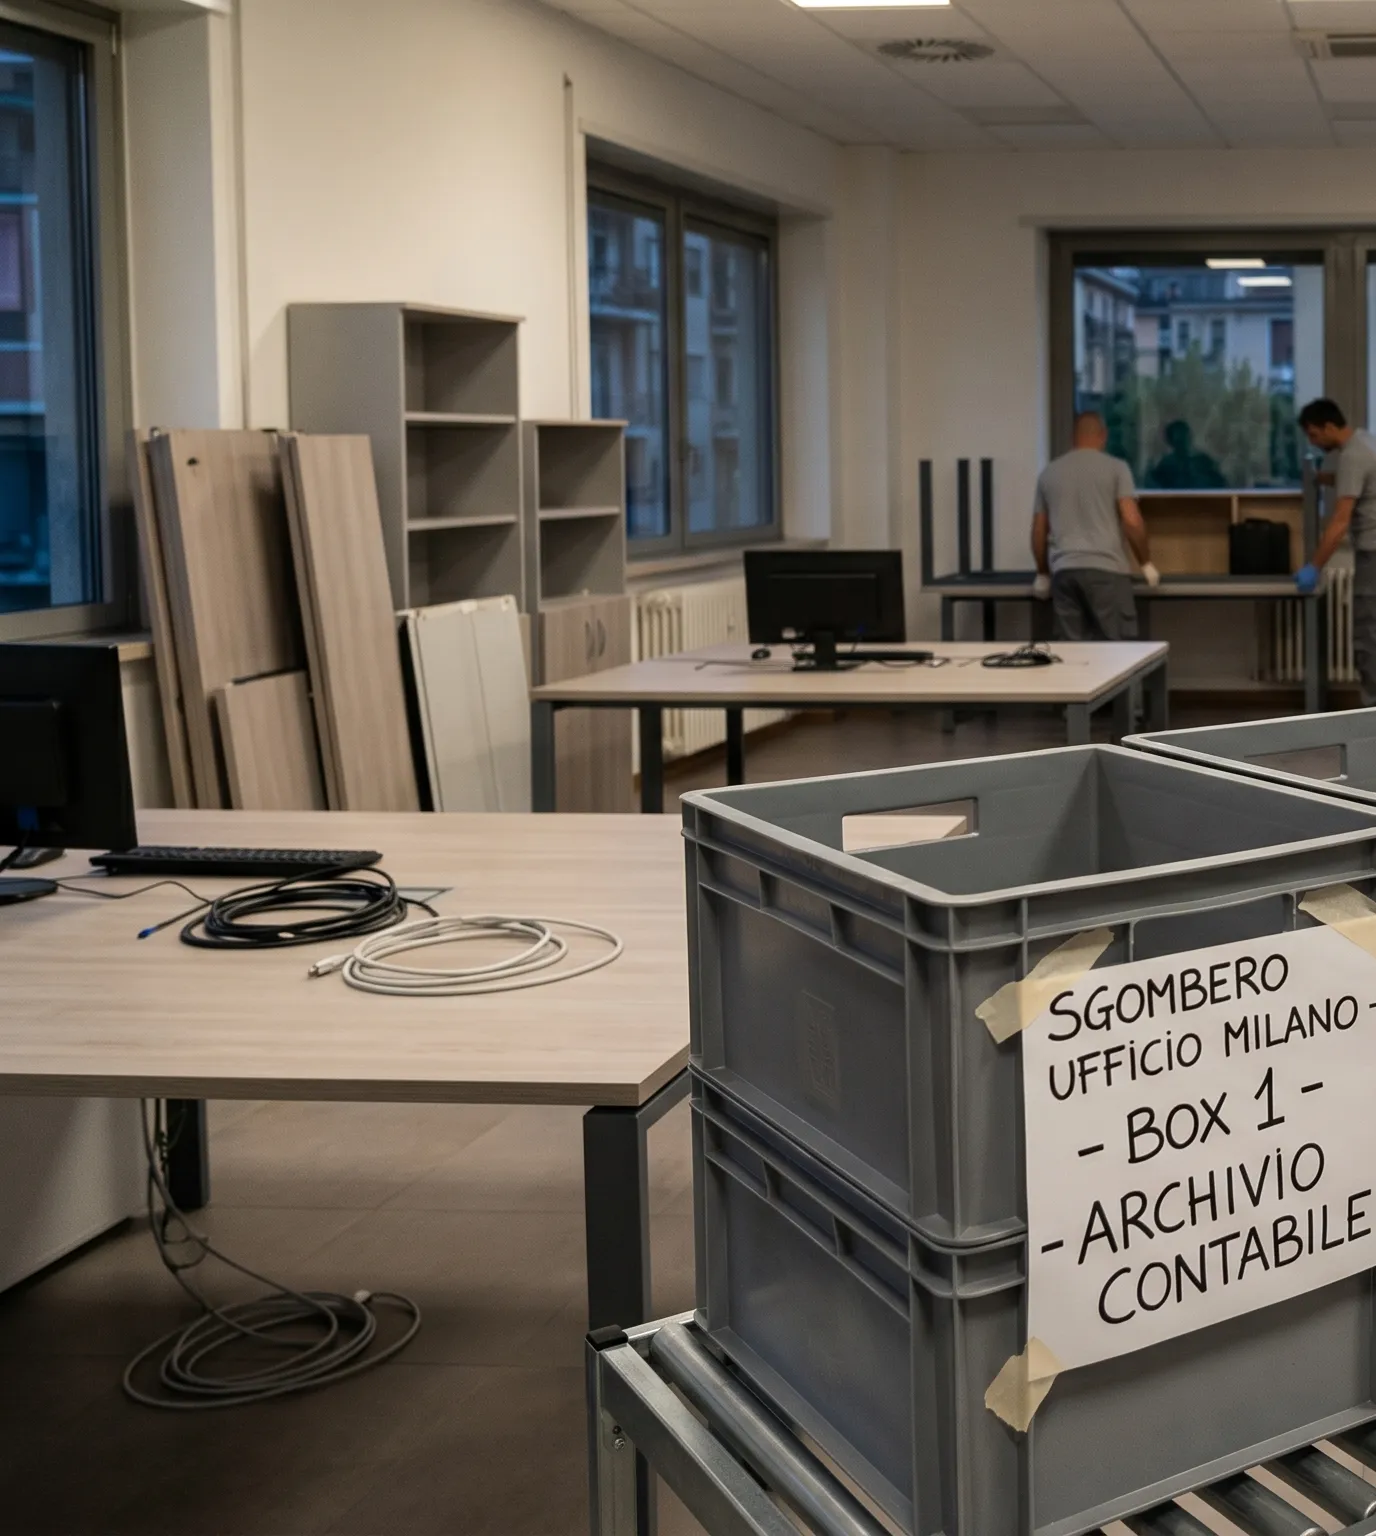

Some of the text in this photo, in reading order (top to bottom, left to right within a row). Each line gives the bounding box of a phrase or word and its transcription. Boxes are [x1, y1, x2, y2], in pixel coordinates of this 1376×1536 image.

[1048, 954, 1289, 1042] SGOMBERO
[1127, 1092, 1231, 1164] BOX
[1254, 1066, 1285, 1131] 1
[1099, 1189, 1372, 1325] CONTABILE
